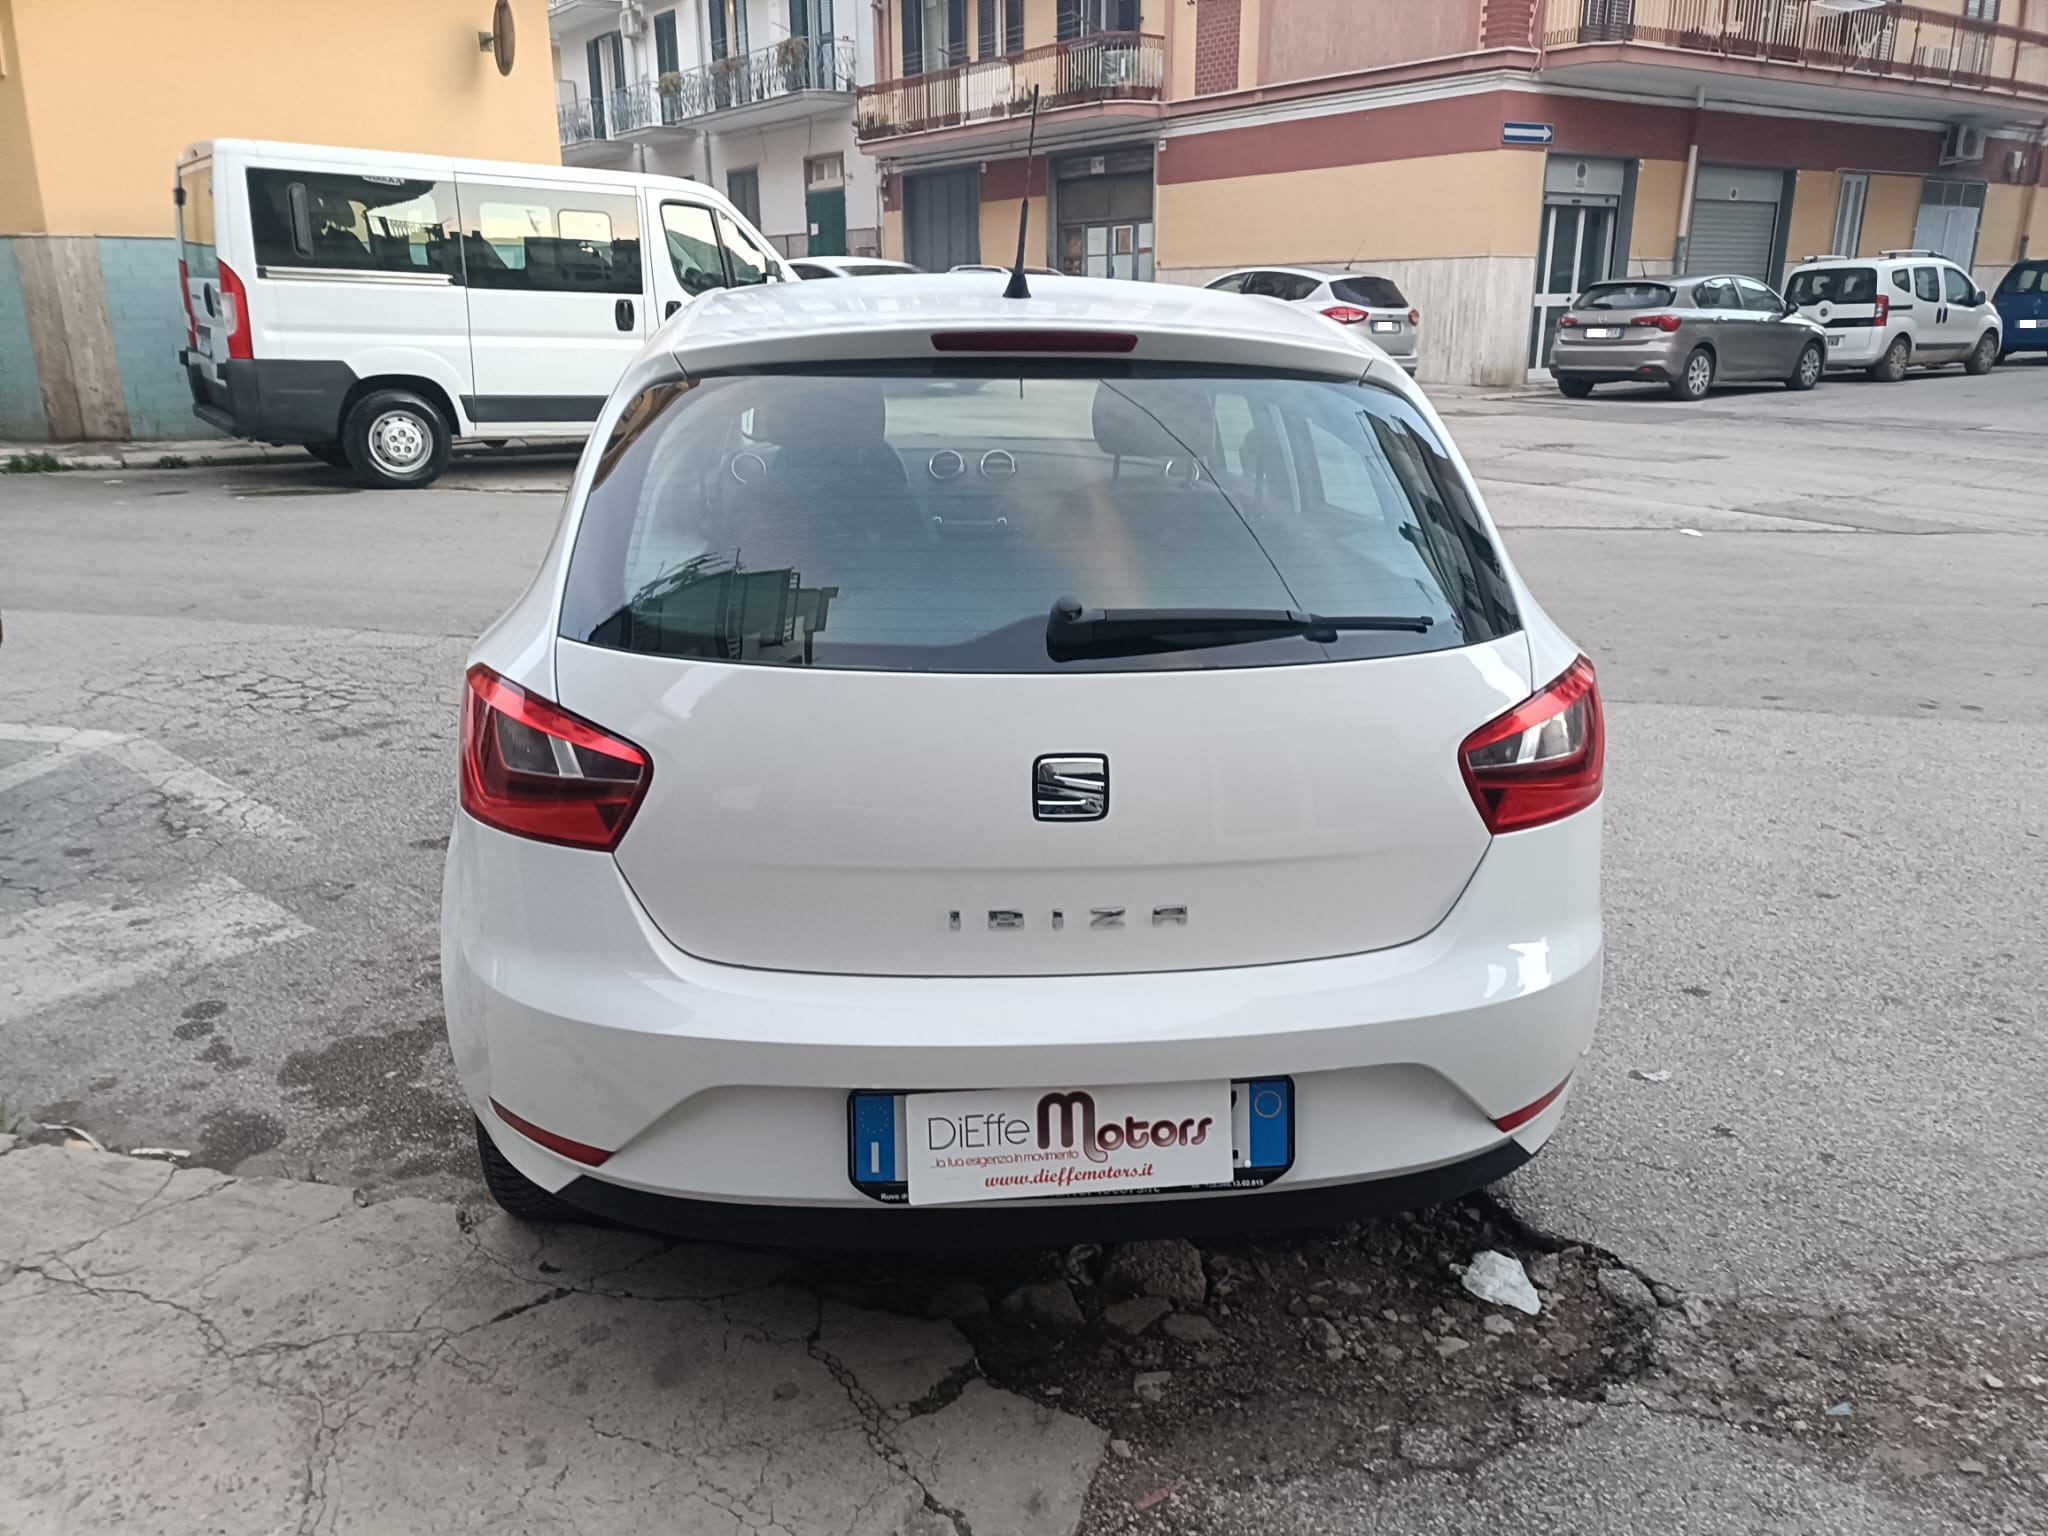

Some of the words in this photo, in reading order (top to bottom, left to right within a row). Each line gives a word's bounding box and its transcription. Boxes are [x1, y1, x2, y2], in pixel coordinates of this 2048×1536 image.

[949, 904, 1188, 929] IBIZA
[928, 1113, 1030, 1153] DiEffe
[1036, 1090, 1214, 1164] Motors
[947, 1157, 964, 1168] tua
[1023, 1150, 1079, 1163] movimento
[984, 1162, 1154, 1190] www.dieffemotors.it
